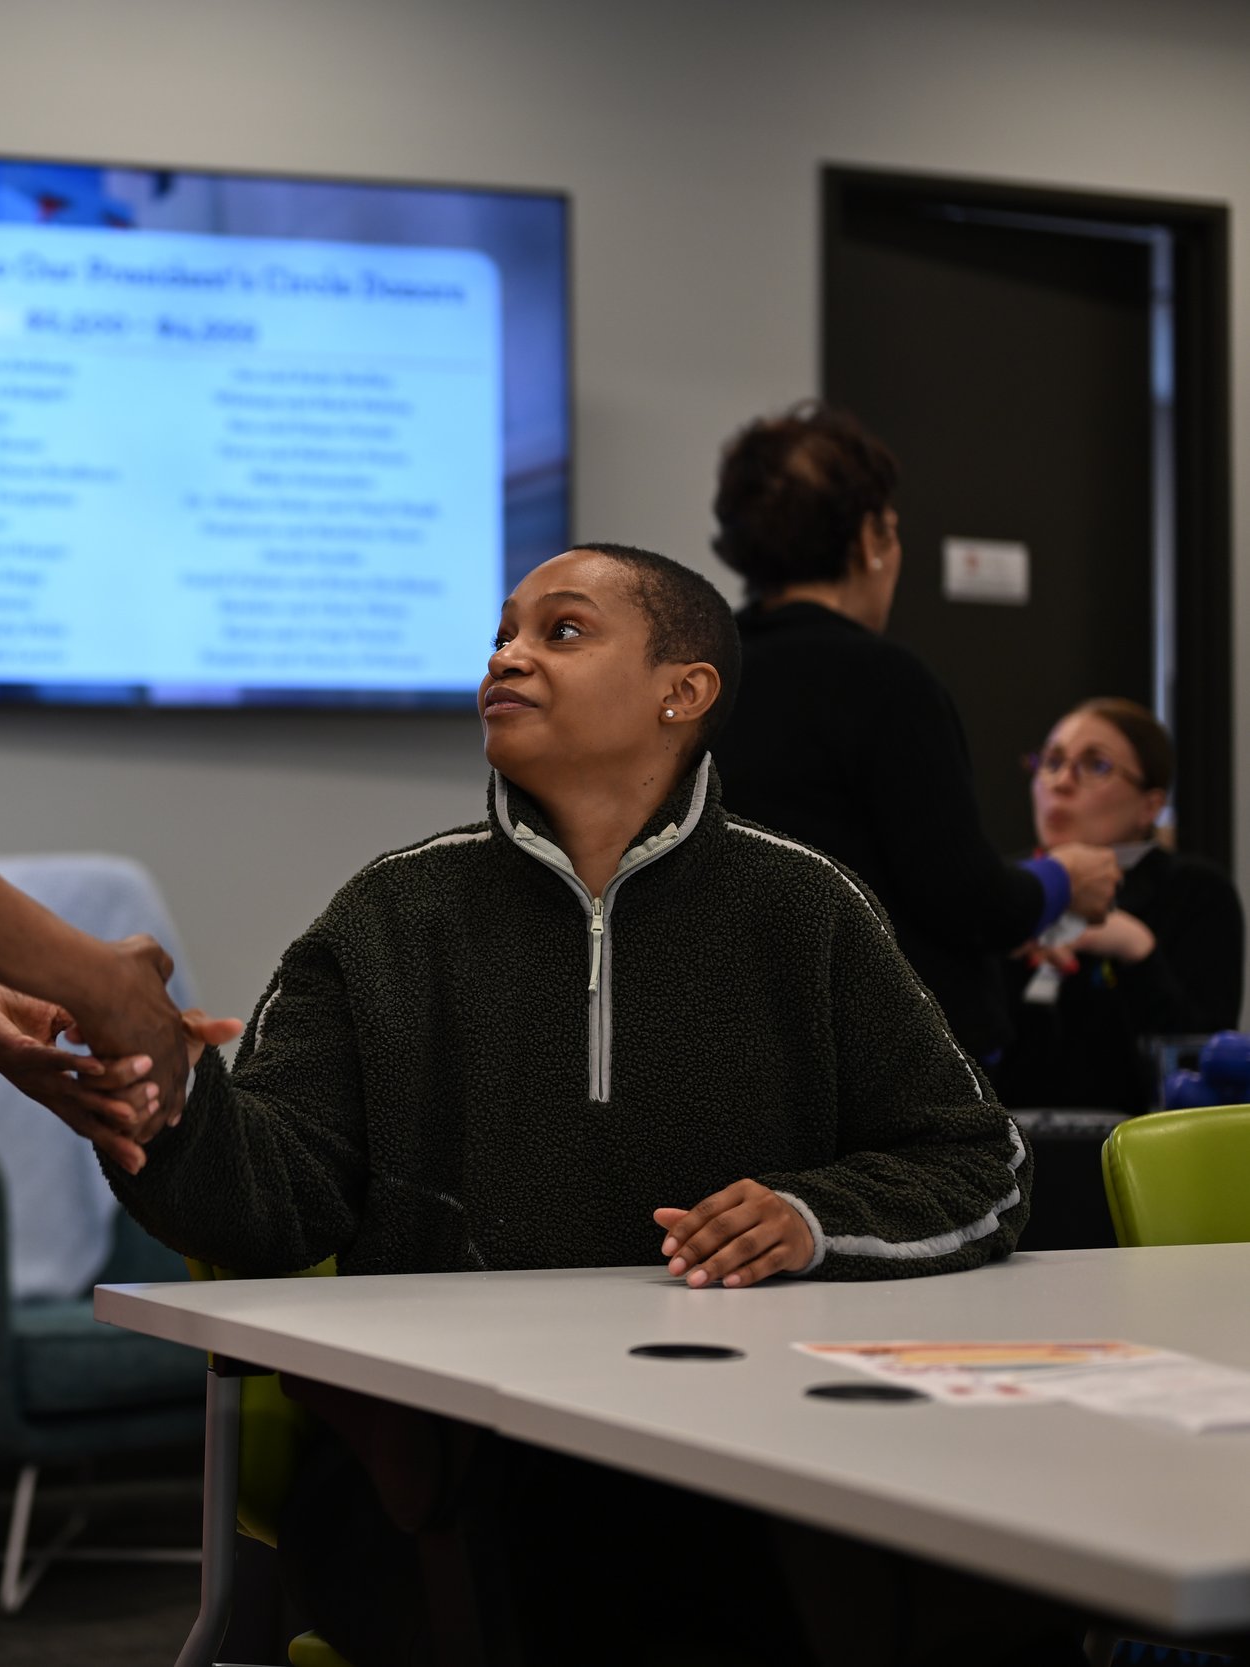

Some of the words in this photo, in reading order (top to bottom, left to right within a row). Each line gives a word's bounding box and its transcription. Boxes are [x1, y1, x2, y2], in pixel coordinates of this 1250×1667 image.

[18, 254, 73, 285] Our
[86, 256, 254, 293] President's
[263, 264, 351, 298] Circle
[359, 269, 465, 305] Donors
